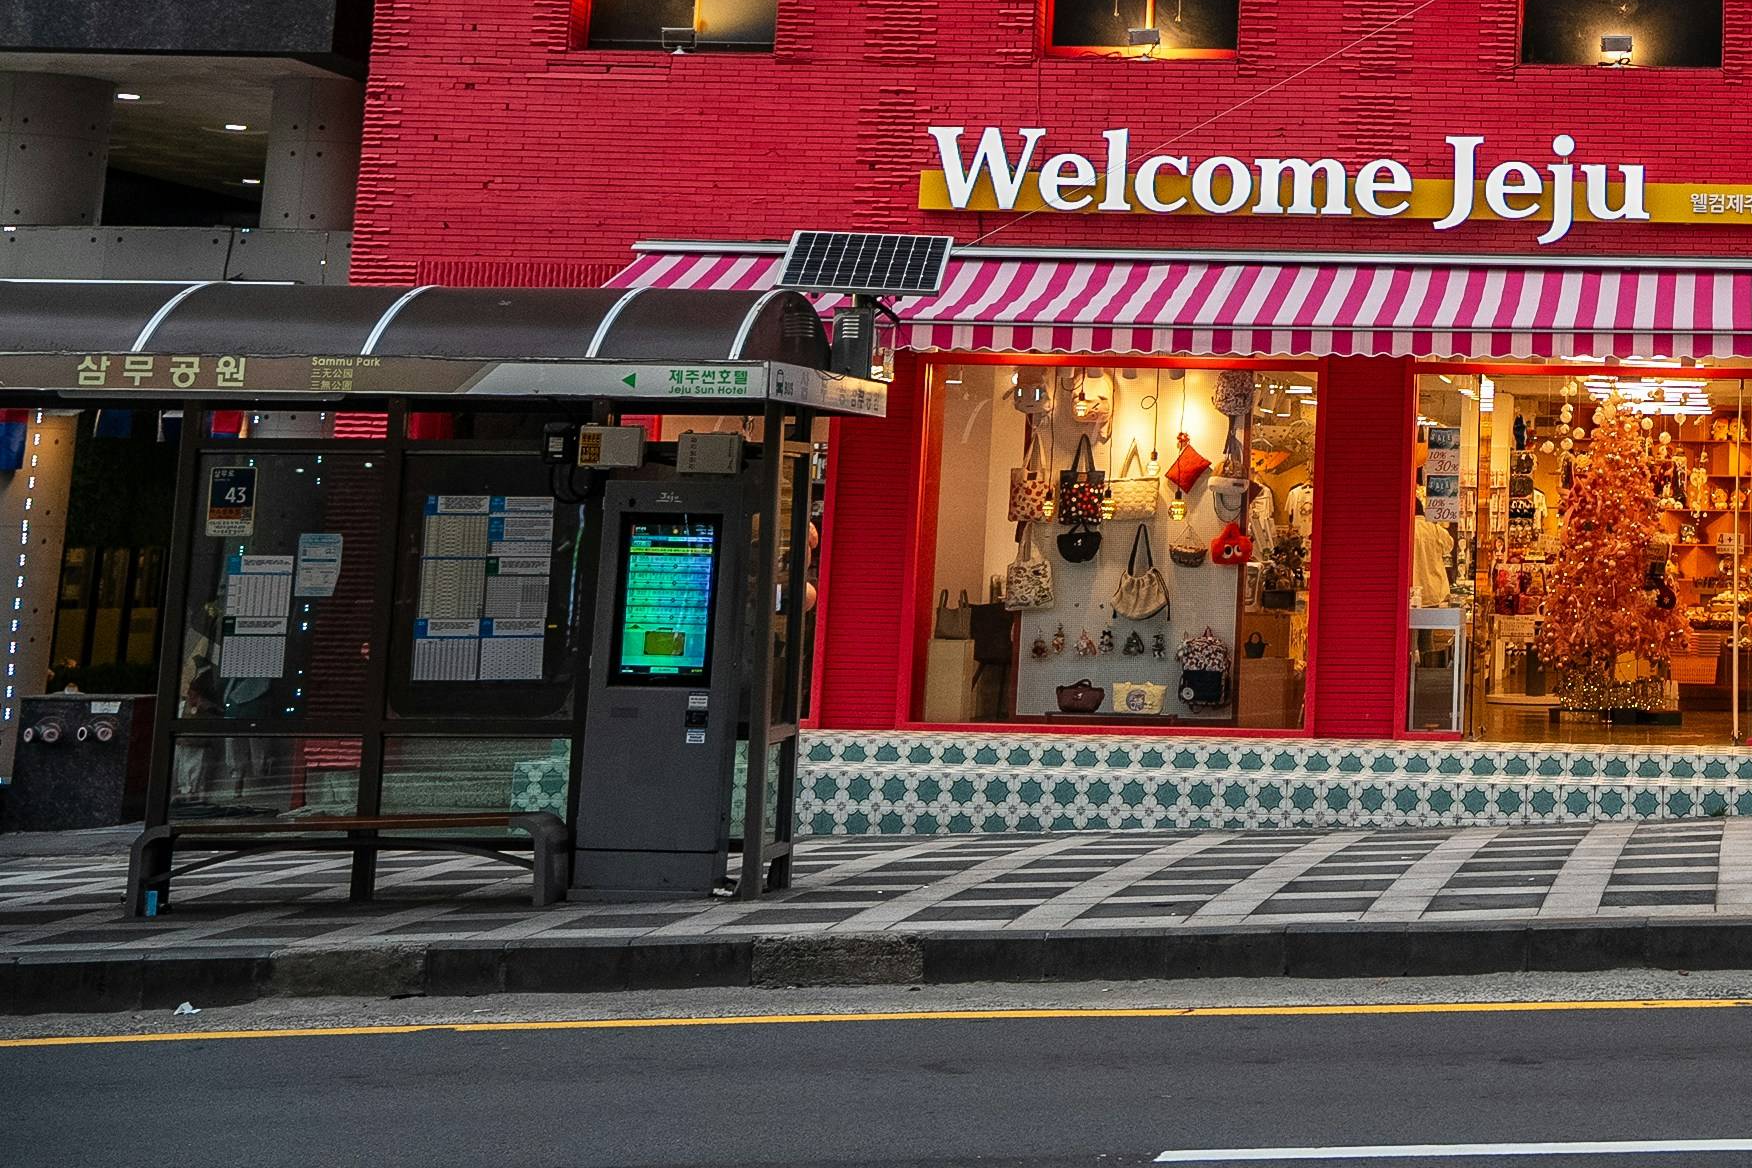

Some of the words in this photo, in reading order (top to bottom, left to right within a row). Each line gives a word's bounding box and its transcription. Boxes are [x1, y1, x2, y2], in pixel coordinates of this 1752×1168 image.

[928, 126, 1413, 217] Welcome
[1432, 134, 1651, 246] Jeju
[311, 356, 353, 366] Sammu
[356, 357, 381, 366] Park
[77, 356, 247, 388] 삼무공원
[668, 370, 748, 385] 제주썬호텔
[668, 385, 692, 395] Jeju
[694, 385, 714, 394] Sun
[717, 386, 747, 395] Hotel
[224, 486, 247, 504] 43
